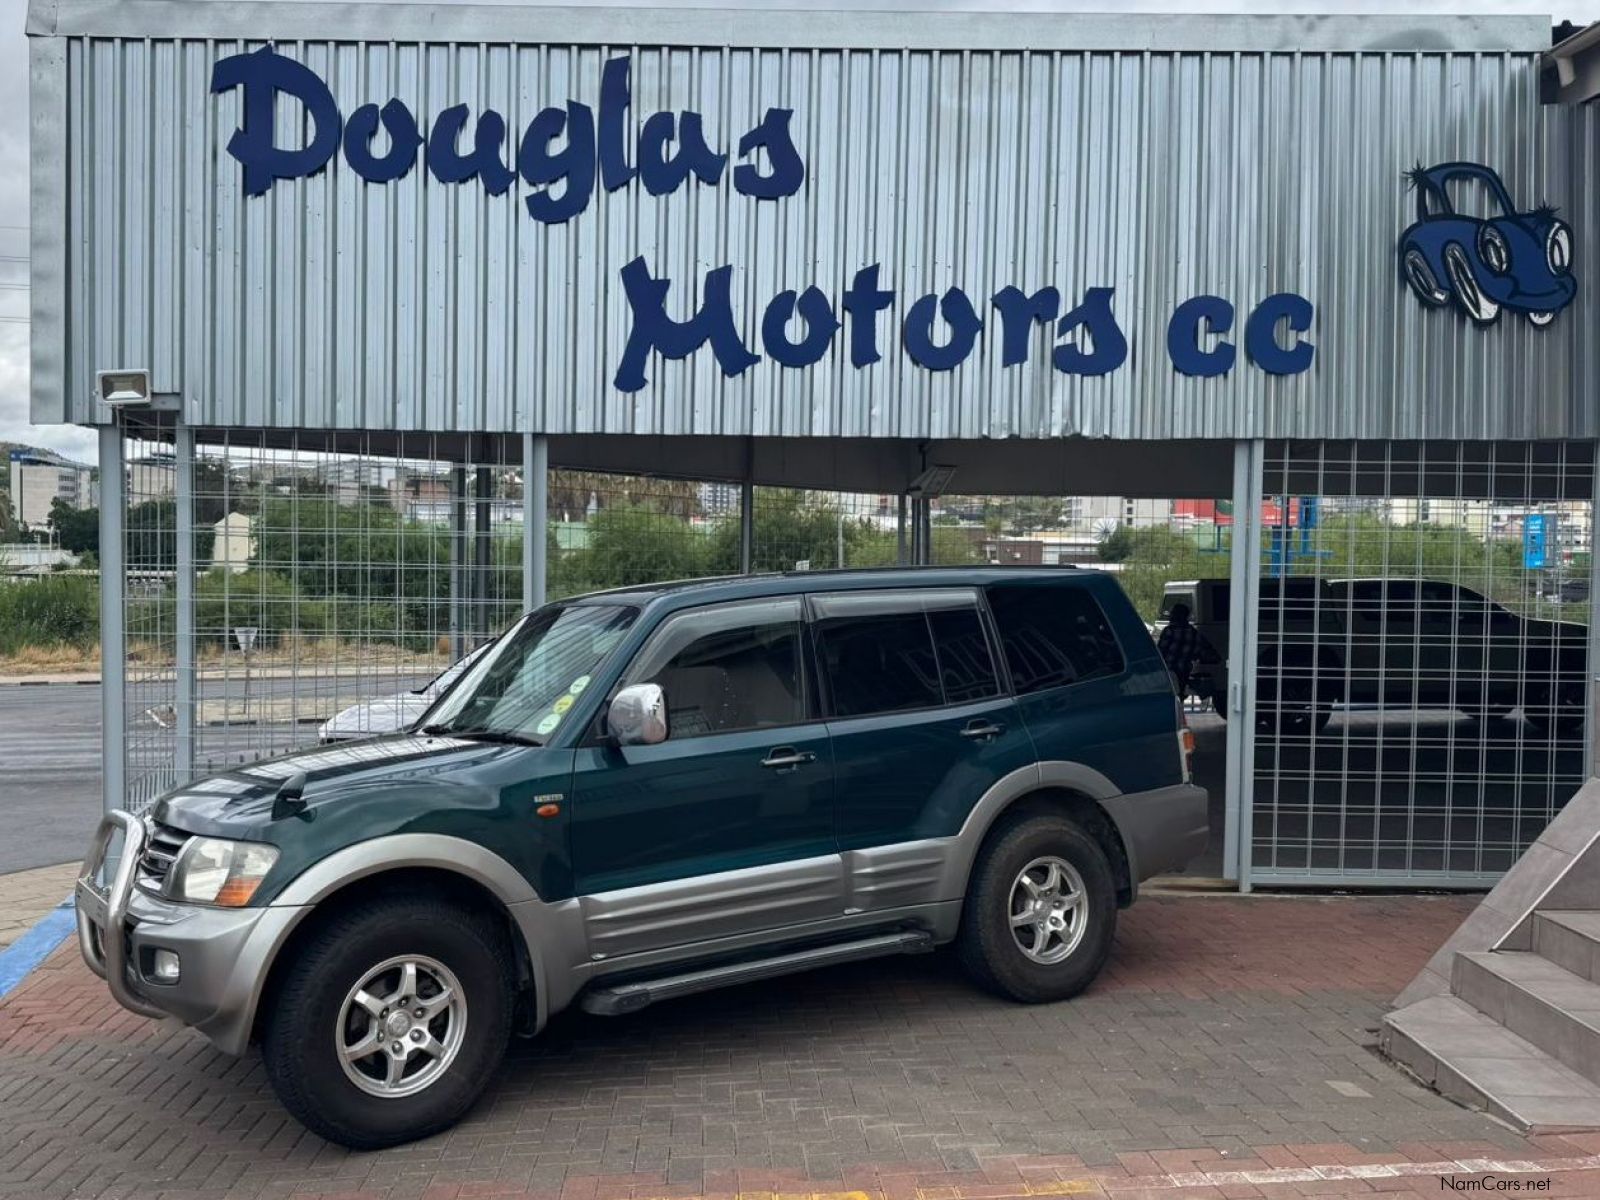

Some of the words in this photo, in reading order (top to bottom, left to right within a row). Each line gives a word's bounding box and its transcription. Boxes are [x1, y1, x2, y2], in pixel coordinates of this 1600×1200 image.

[210, 44, 806, 224] Douglas
[613, 256, 1128, 393] Motors
[1167, 293, 1316, 378] cc
